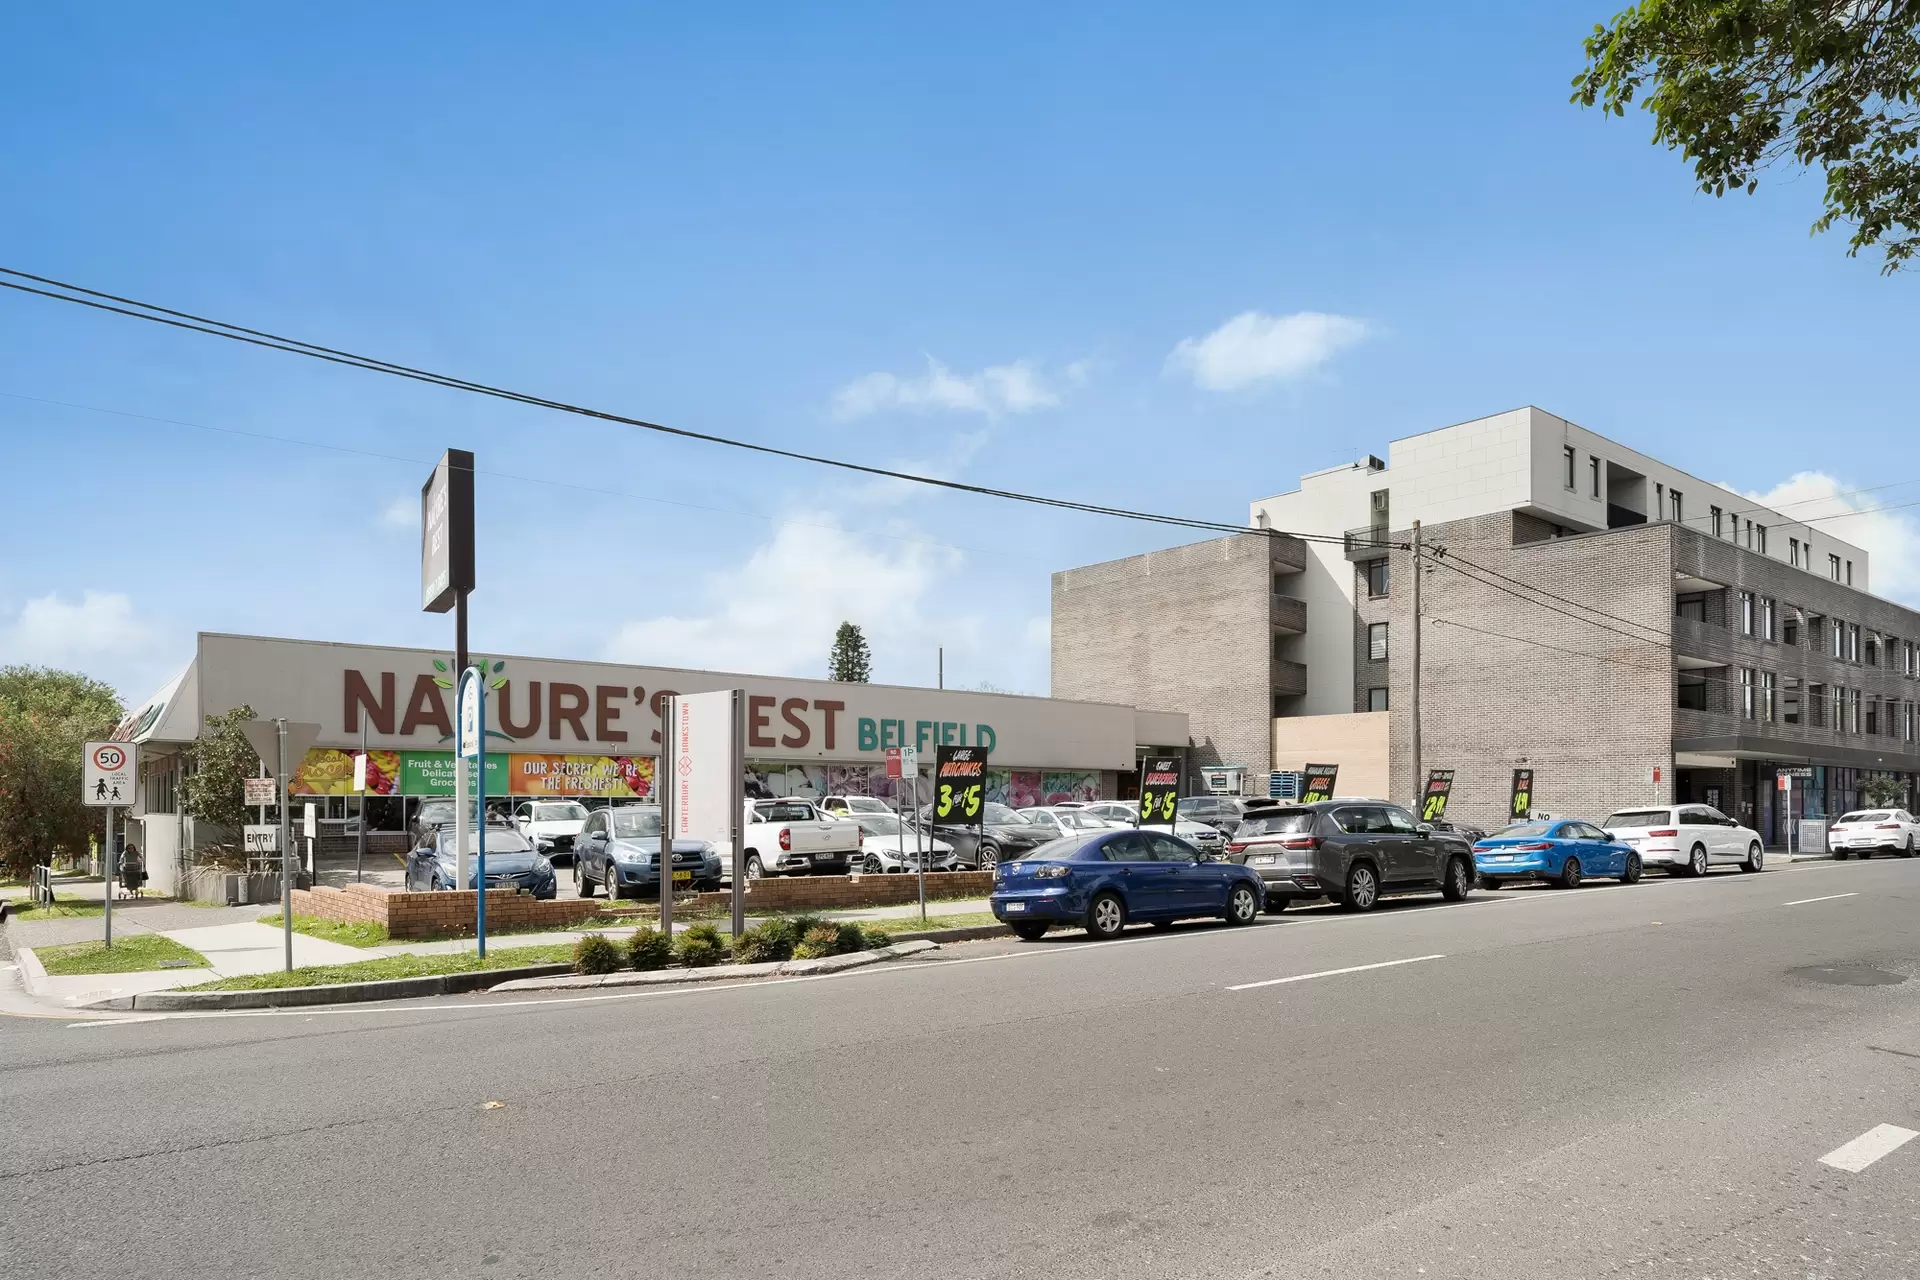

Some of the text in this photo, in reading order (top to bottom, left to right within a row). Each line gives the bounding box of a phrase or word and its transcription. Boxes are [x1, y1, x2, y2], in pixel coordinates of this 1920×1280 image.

[344, 669, 681, 744] NAURE'
[749, 695, 845, 750] EST
[858, 717, 996, 755] BELFIELD
[100, 753, 120, 764] 50
[904, 748, 914, 756] 1P
[953, 750, 972, 761] LARGE
[408, 760, 497, 769] Fruit & Vetales
[523, 761, 547, 775] OUR
[602, 764, 638, 777] WE'RE
[940, 762, 982, 777] ARTICHOKES
[422, 769, 478, 777] Delicatse
[541, 777, 623, 790] THE FRESHEST!
[681, 780, 689, 833] CANTERBURY
[937, 785, 952, 817] 3
[962, 785, 980, 816] $5
[1142, 792, 1153, 819] 3
